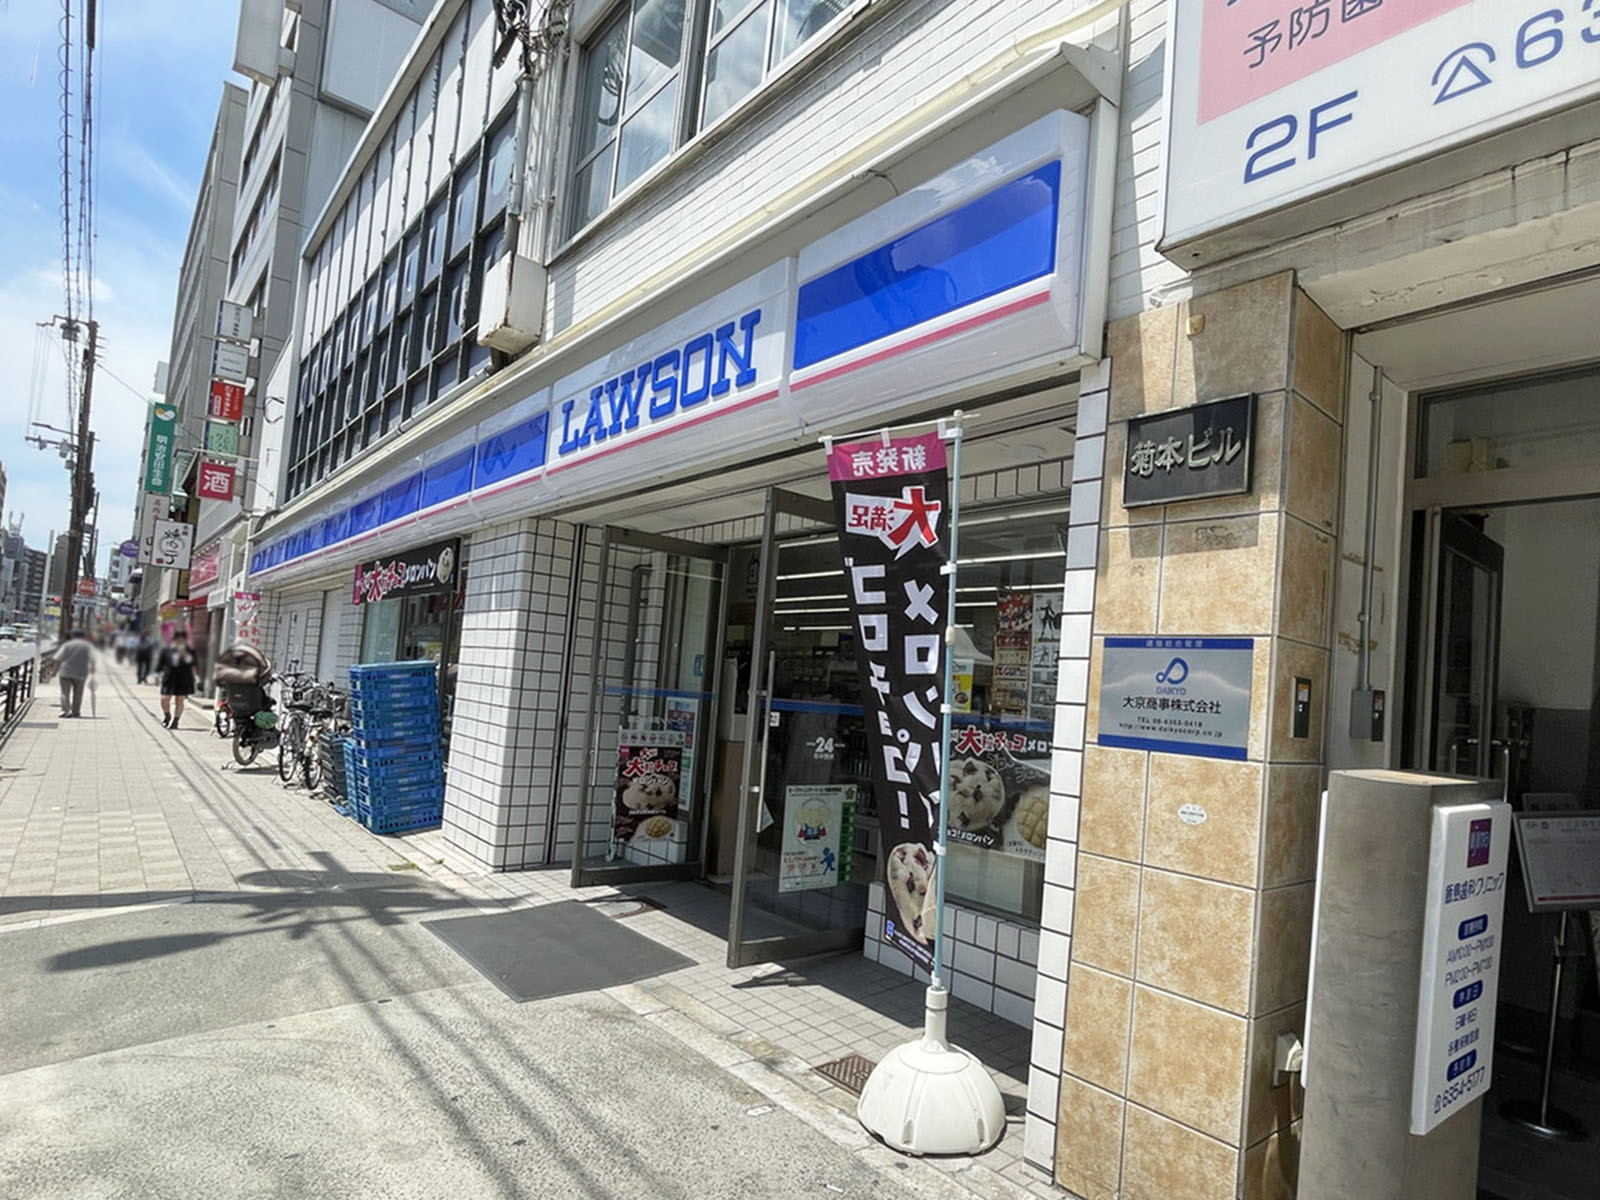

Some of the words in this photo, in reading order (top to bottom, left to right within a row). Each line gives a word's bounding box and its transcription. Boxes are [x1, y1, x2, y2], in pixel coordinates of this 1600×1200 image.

[1243, 90, 1358, 184] 2F
[558, 308, 762, 456] LAWSON
[1130, 427, 1241, 477] 菊本ビル
[202, 468, 231, 494] 酒
[1156, 687, 1187, 696] DAIKYO
[1122, 696, 1222, 714] 大京商事株式会社
[1137, 716, 1150, 724] TEL
[815, 736, 834, 753] 24
